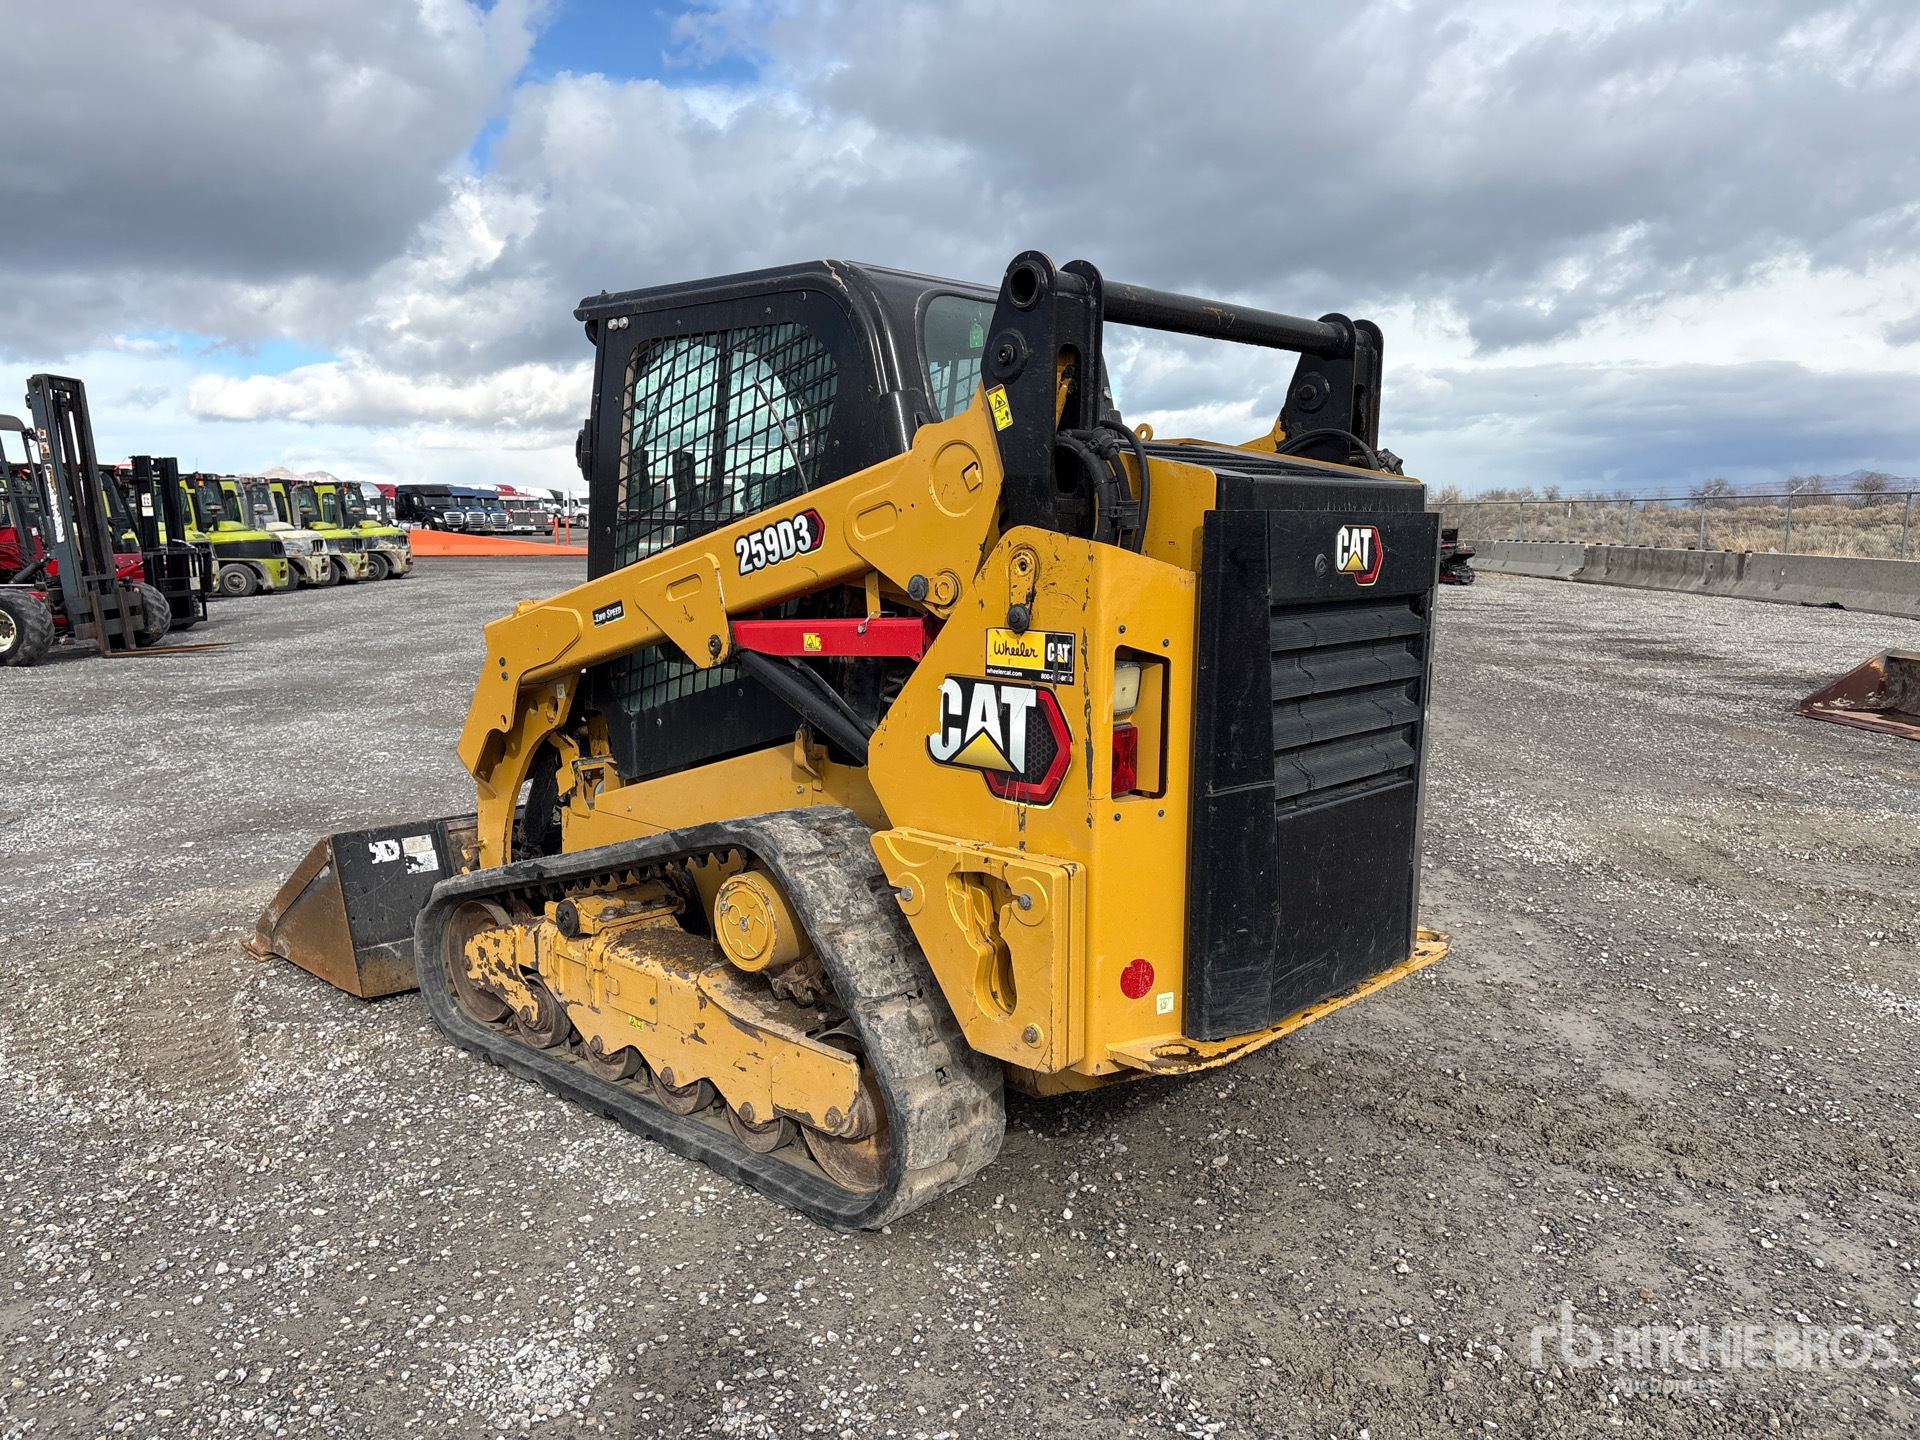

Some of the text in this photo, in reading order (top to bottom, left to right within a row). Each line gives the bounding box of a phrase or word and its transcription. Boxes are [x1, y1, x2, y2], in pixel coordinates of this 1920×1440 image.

[735, 514, 812, 574] 259D3
[1336, 526, 1372, 571] CAT
[993, 640, 1072, 664] Wheeler CAT
[929, 678, 1037, 775] CAT
